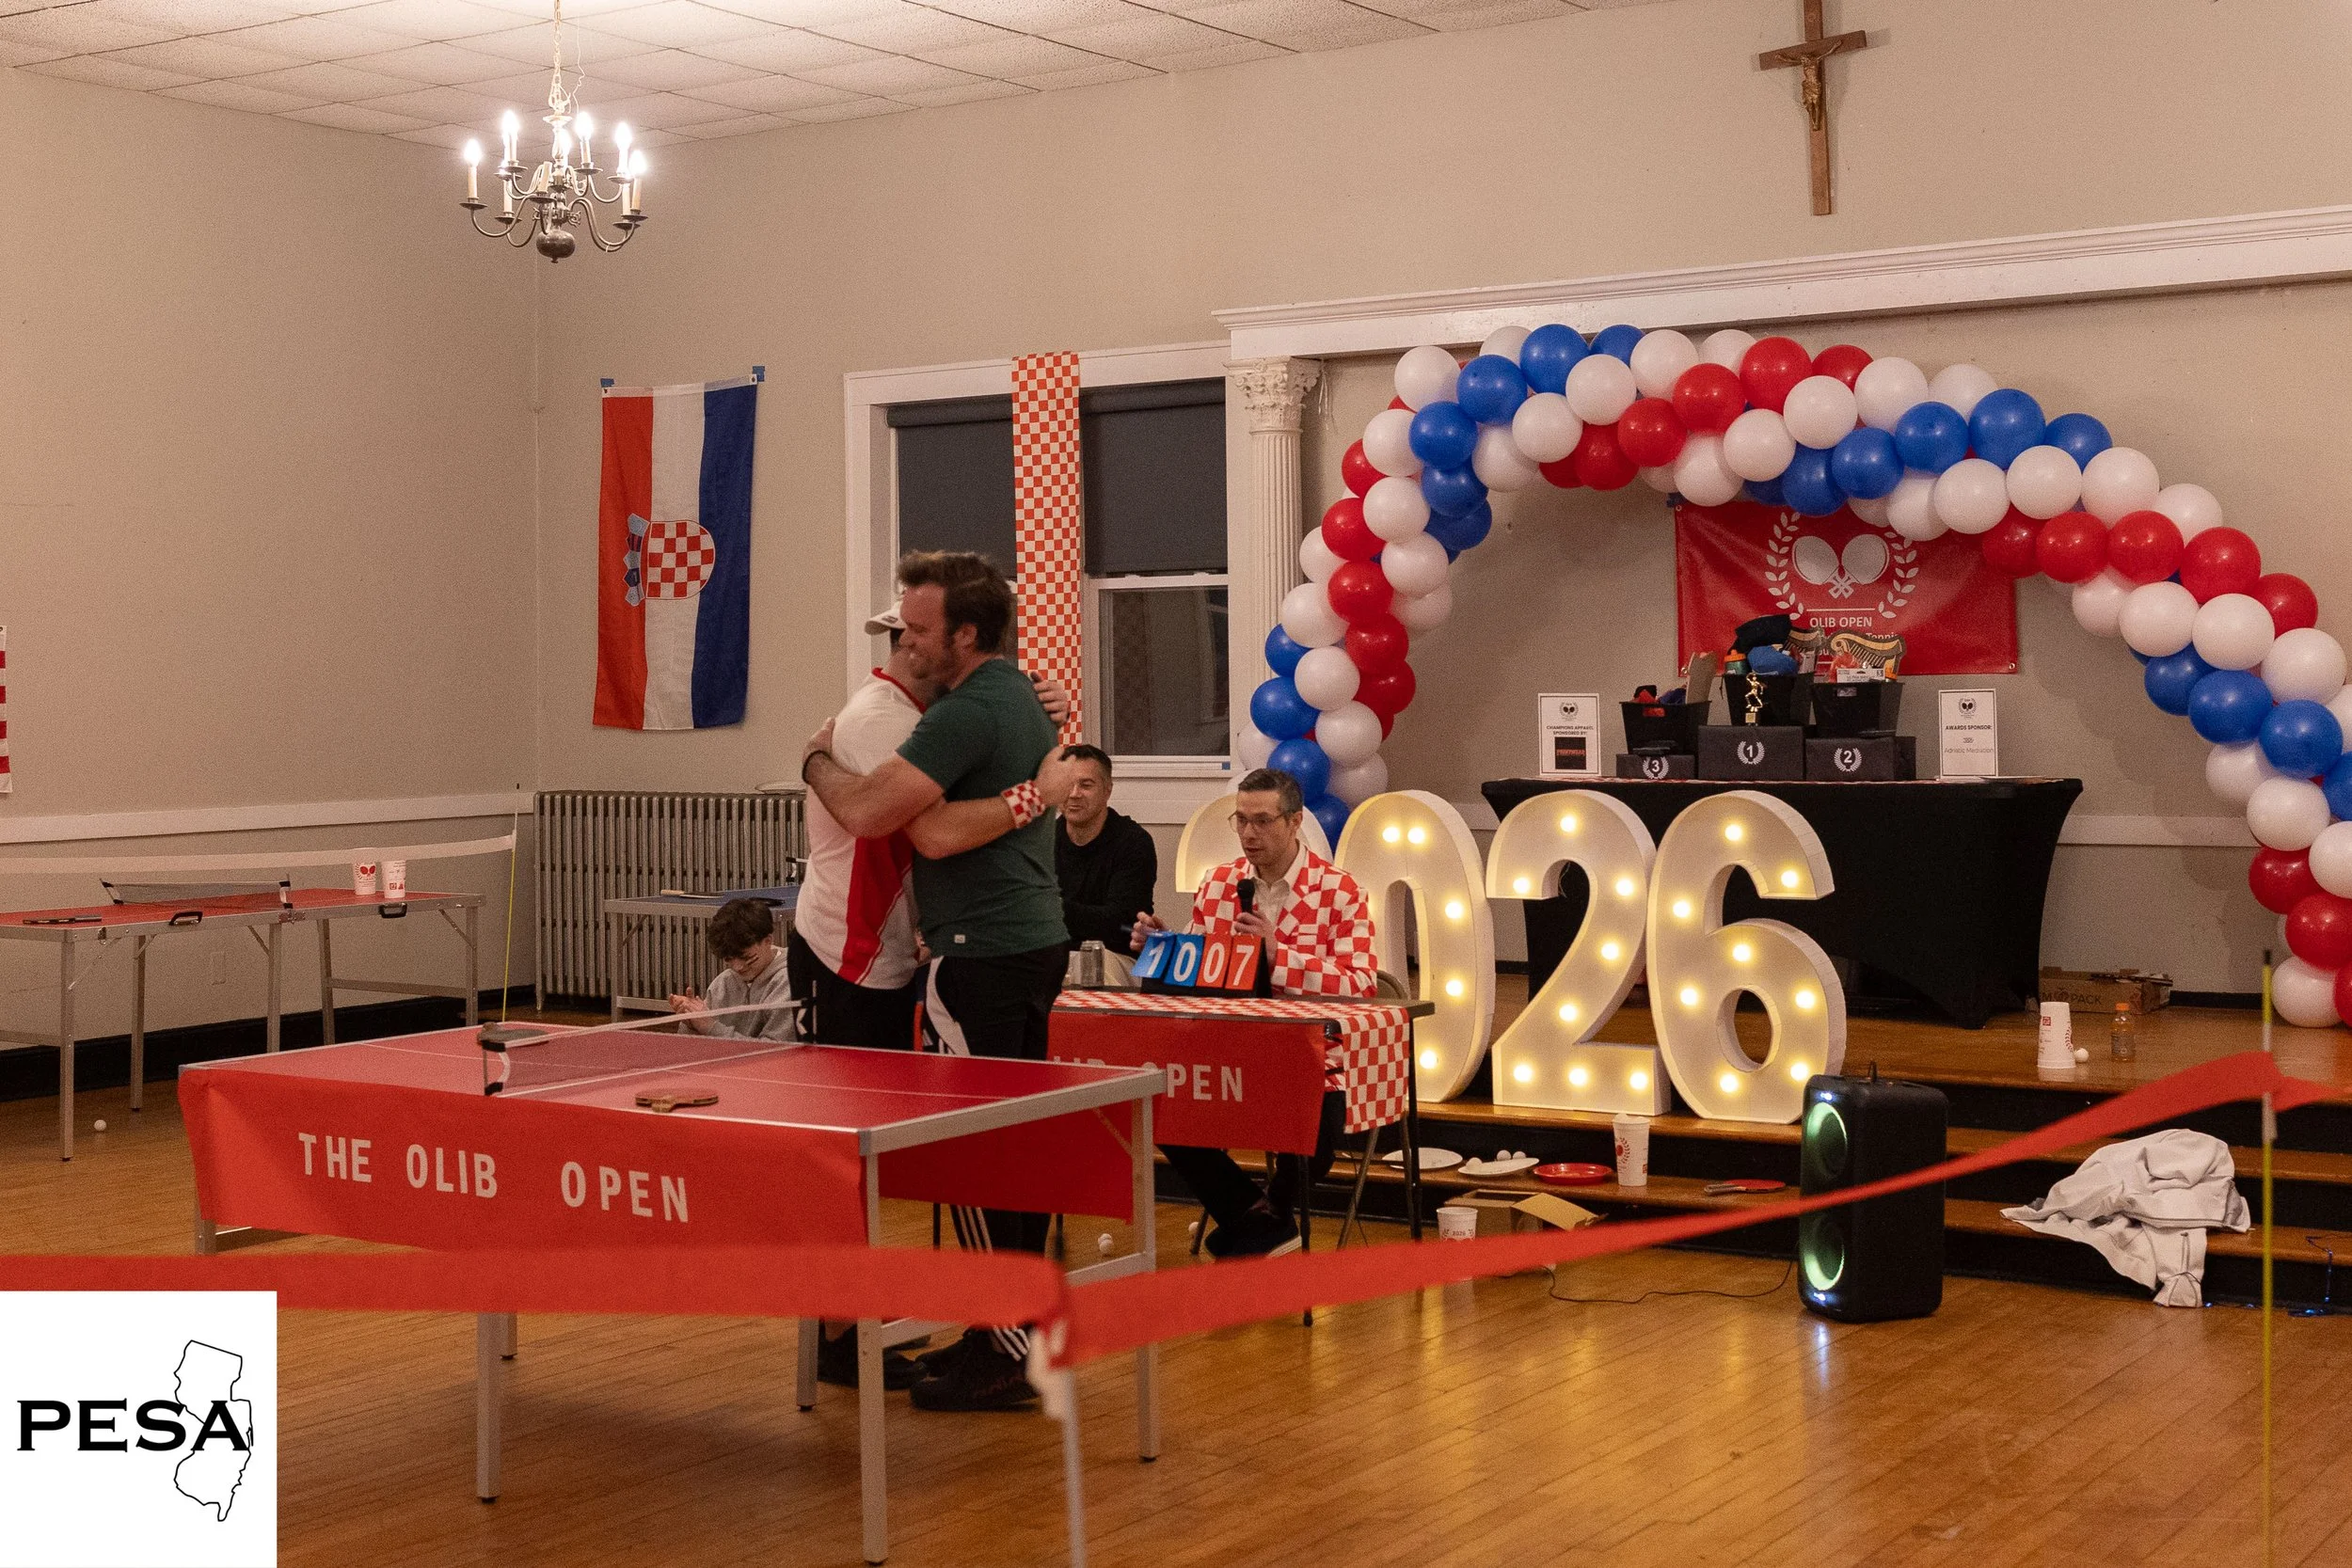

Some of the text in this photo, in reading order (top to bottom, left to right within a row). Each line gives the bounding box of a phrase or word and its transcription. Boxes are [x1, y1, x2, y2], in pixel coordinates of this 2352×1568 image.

[1809, 617, 1872, 627] OLIB OPEN
[1746, 744, 1754, 757] 1
[1843, 751, 1852, 763] 2
[1651, 760, 1660, 772] 3
[1142, 1062, 1243, 1101] PEN
[298, 1132, 689, 1223] THE OLIB OPEN
